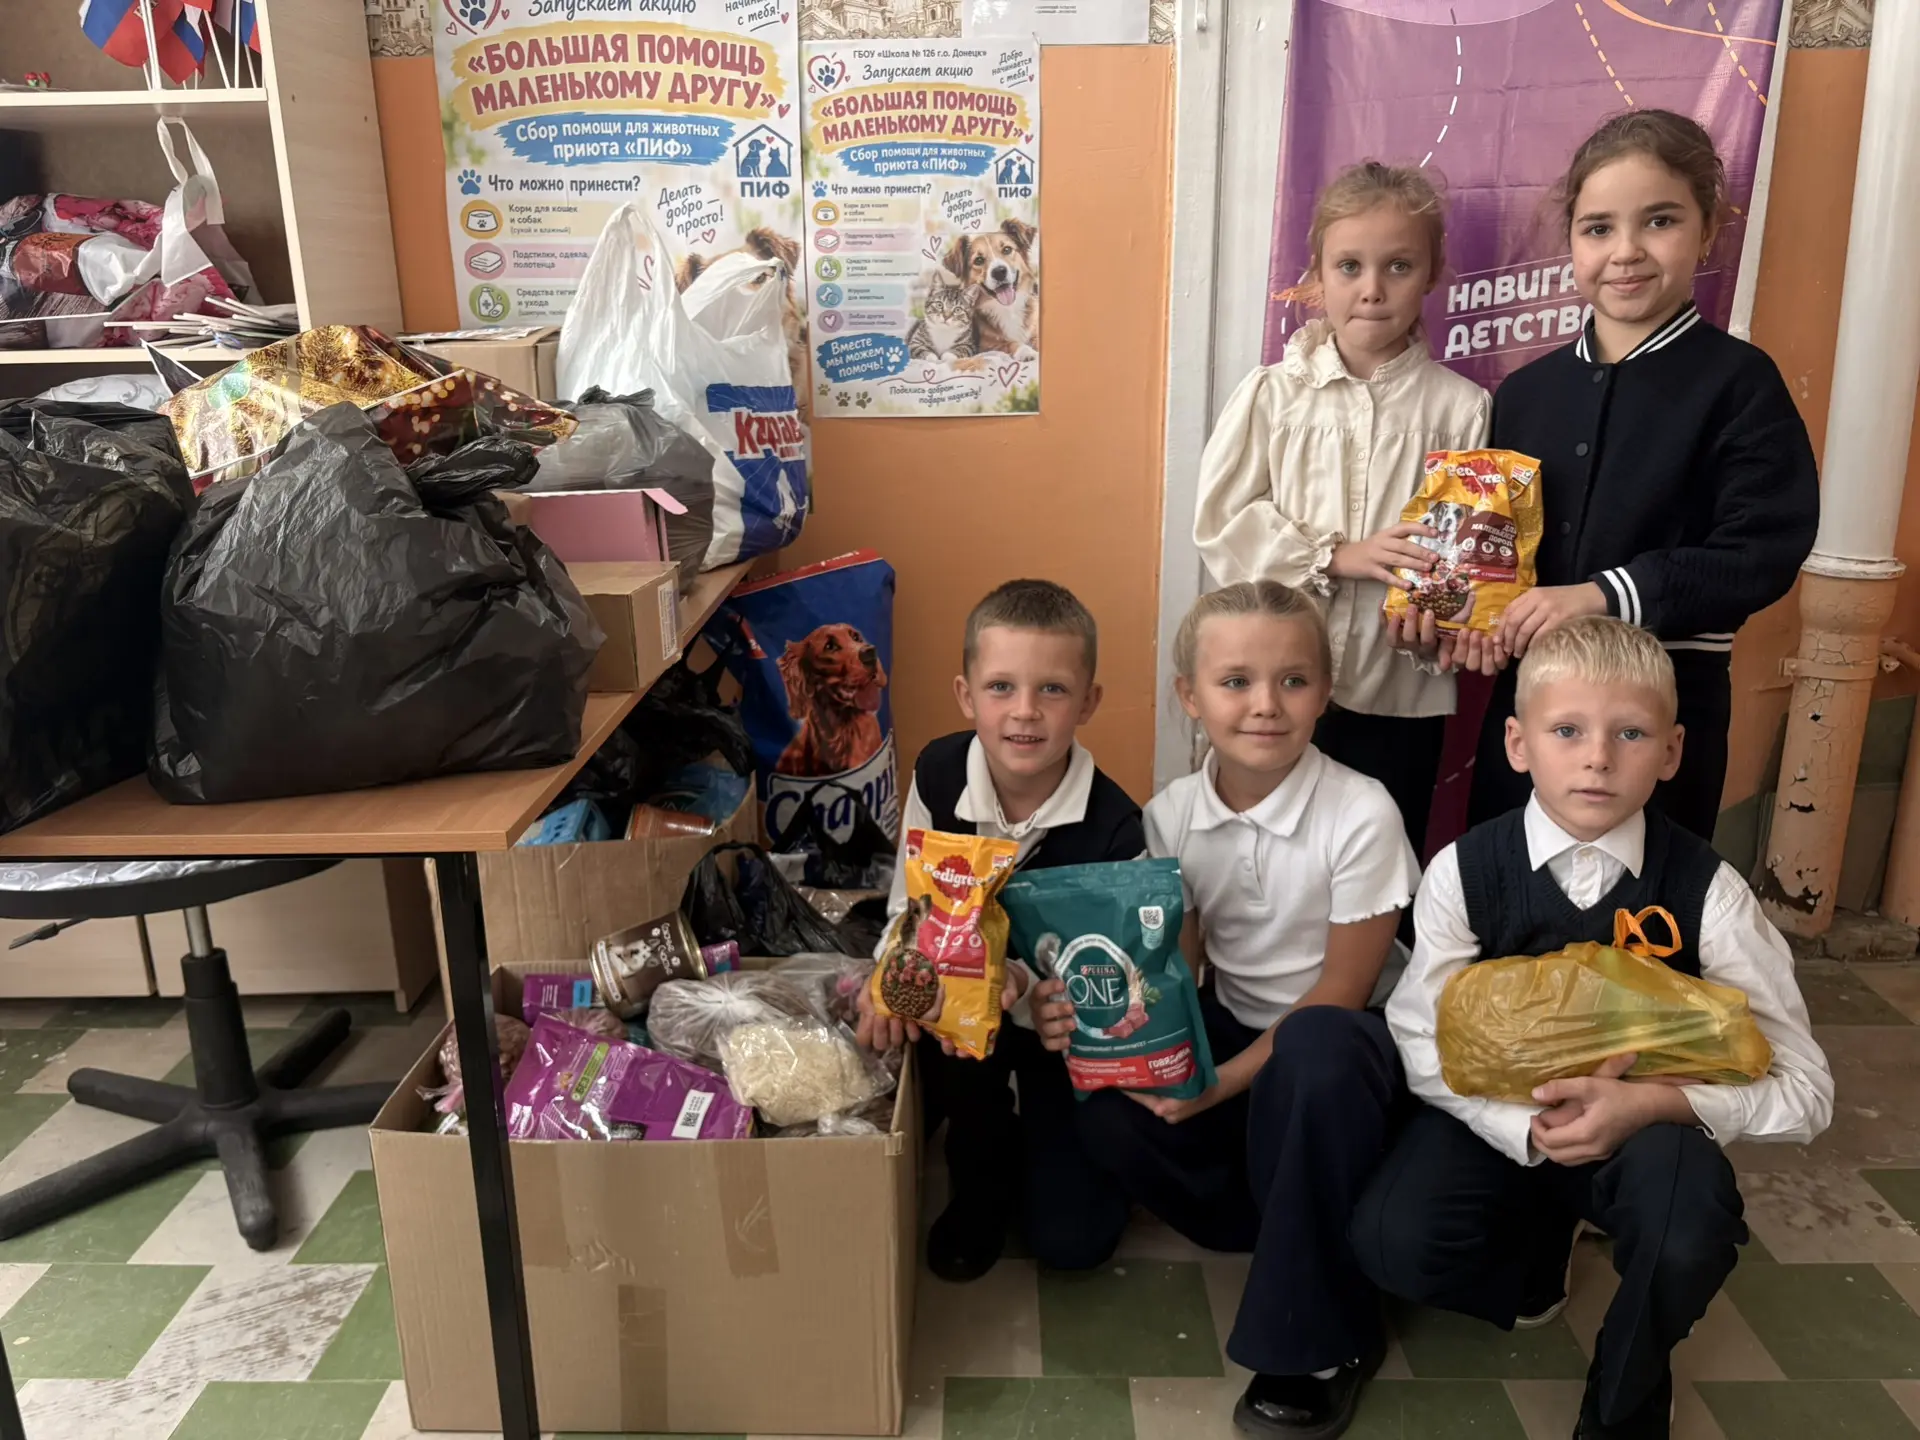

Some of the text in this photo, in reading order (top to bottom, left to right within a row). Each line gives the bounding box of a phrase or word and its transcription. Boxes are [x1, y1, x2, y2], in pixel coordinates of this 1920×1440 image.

[748, 0, 780, 22] тебя!
[468, 34, 765, 77] «БОЛЬШАЯ ПОМОЩЬ
[853, 50, 875, 58] ГБОУ
[877, 49, 910, 59] «Школа
[923, 50, 936, 58] 126
[952, 50, 987, 60] Донецк»
[862, 64, 973, 83] Запускает акцию
[471, 70, 776, 115] МАЛЕНЬКОМУ ДРУГУ»
[821, 90, 1017, 118] «БОЛЬШАЯ ПОМОЩЬ
[516, 121, 720, 143] Сбор помощи для животных
[822, 114, 1024, 145] МАЛЕНЬКОМУ ДРУГУ»
[553, 138, 692, 160] приюта «ПИФ»
[850, 147, 986, 162] Сбор помощи для животных
[874, 159, 967, 173] приюта «ПИФ»
[488, 175, 641, 197] Что можно принести?
[657, 183, 702, 209] Делать
[740, 181, 791, 199] ПИФ
[831, 184, 931, 197] Что можно принести?
[998, 186, 1032, 199] ПИФ
[942, 188, 972, 206] Делать
[508, 204, 532, 216] Корм
[534, 205, 550, 214] для
[666, 199, 703, 227] добро
[947, 198, 973, 218] добро
[954, 203, 987, 224] просто!
[517, 215, 542, 224] собак
[676, 204, 725, 237] просто!
[831, 337, 872, 354] Вместе
[826, 347, 884, 368] мы можем
[839, 359, 884, 378] помочь!
[922, 862, 984, 889] Pedigree
[1066, 974, 1125, 1006] ONE
